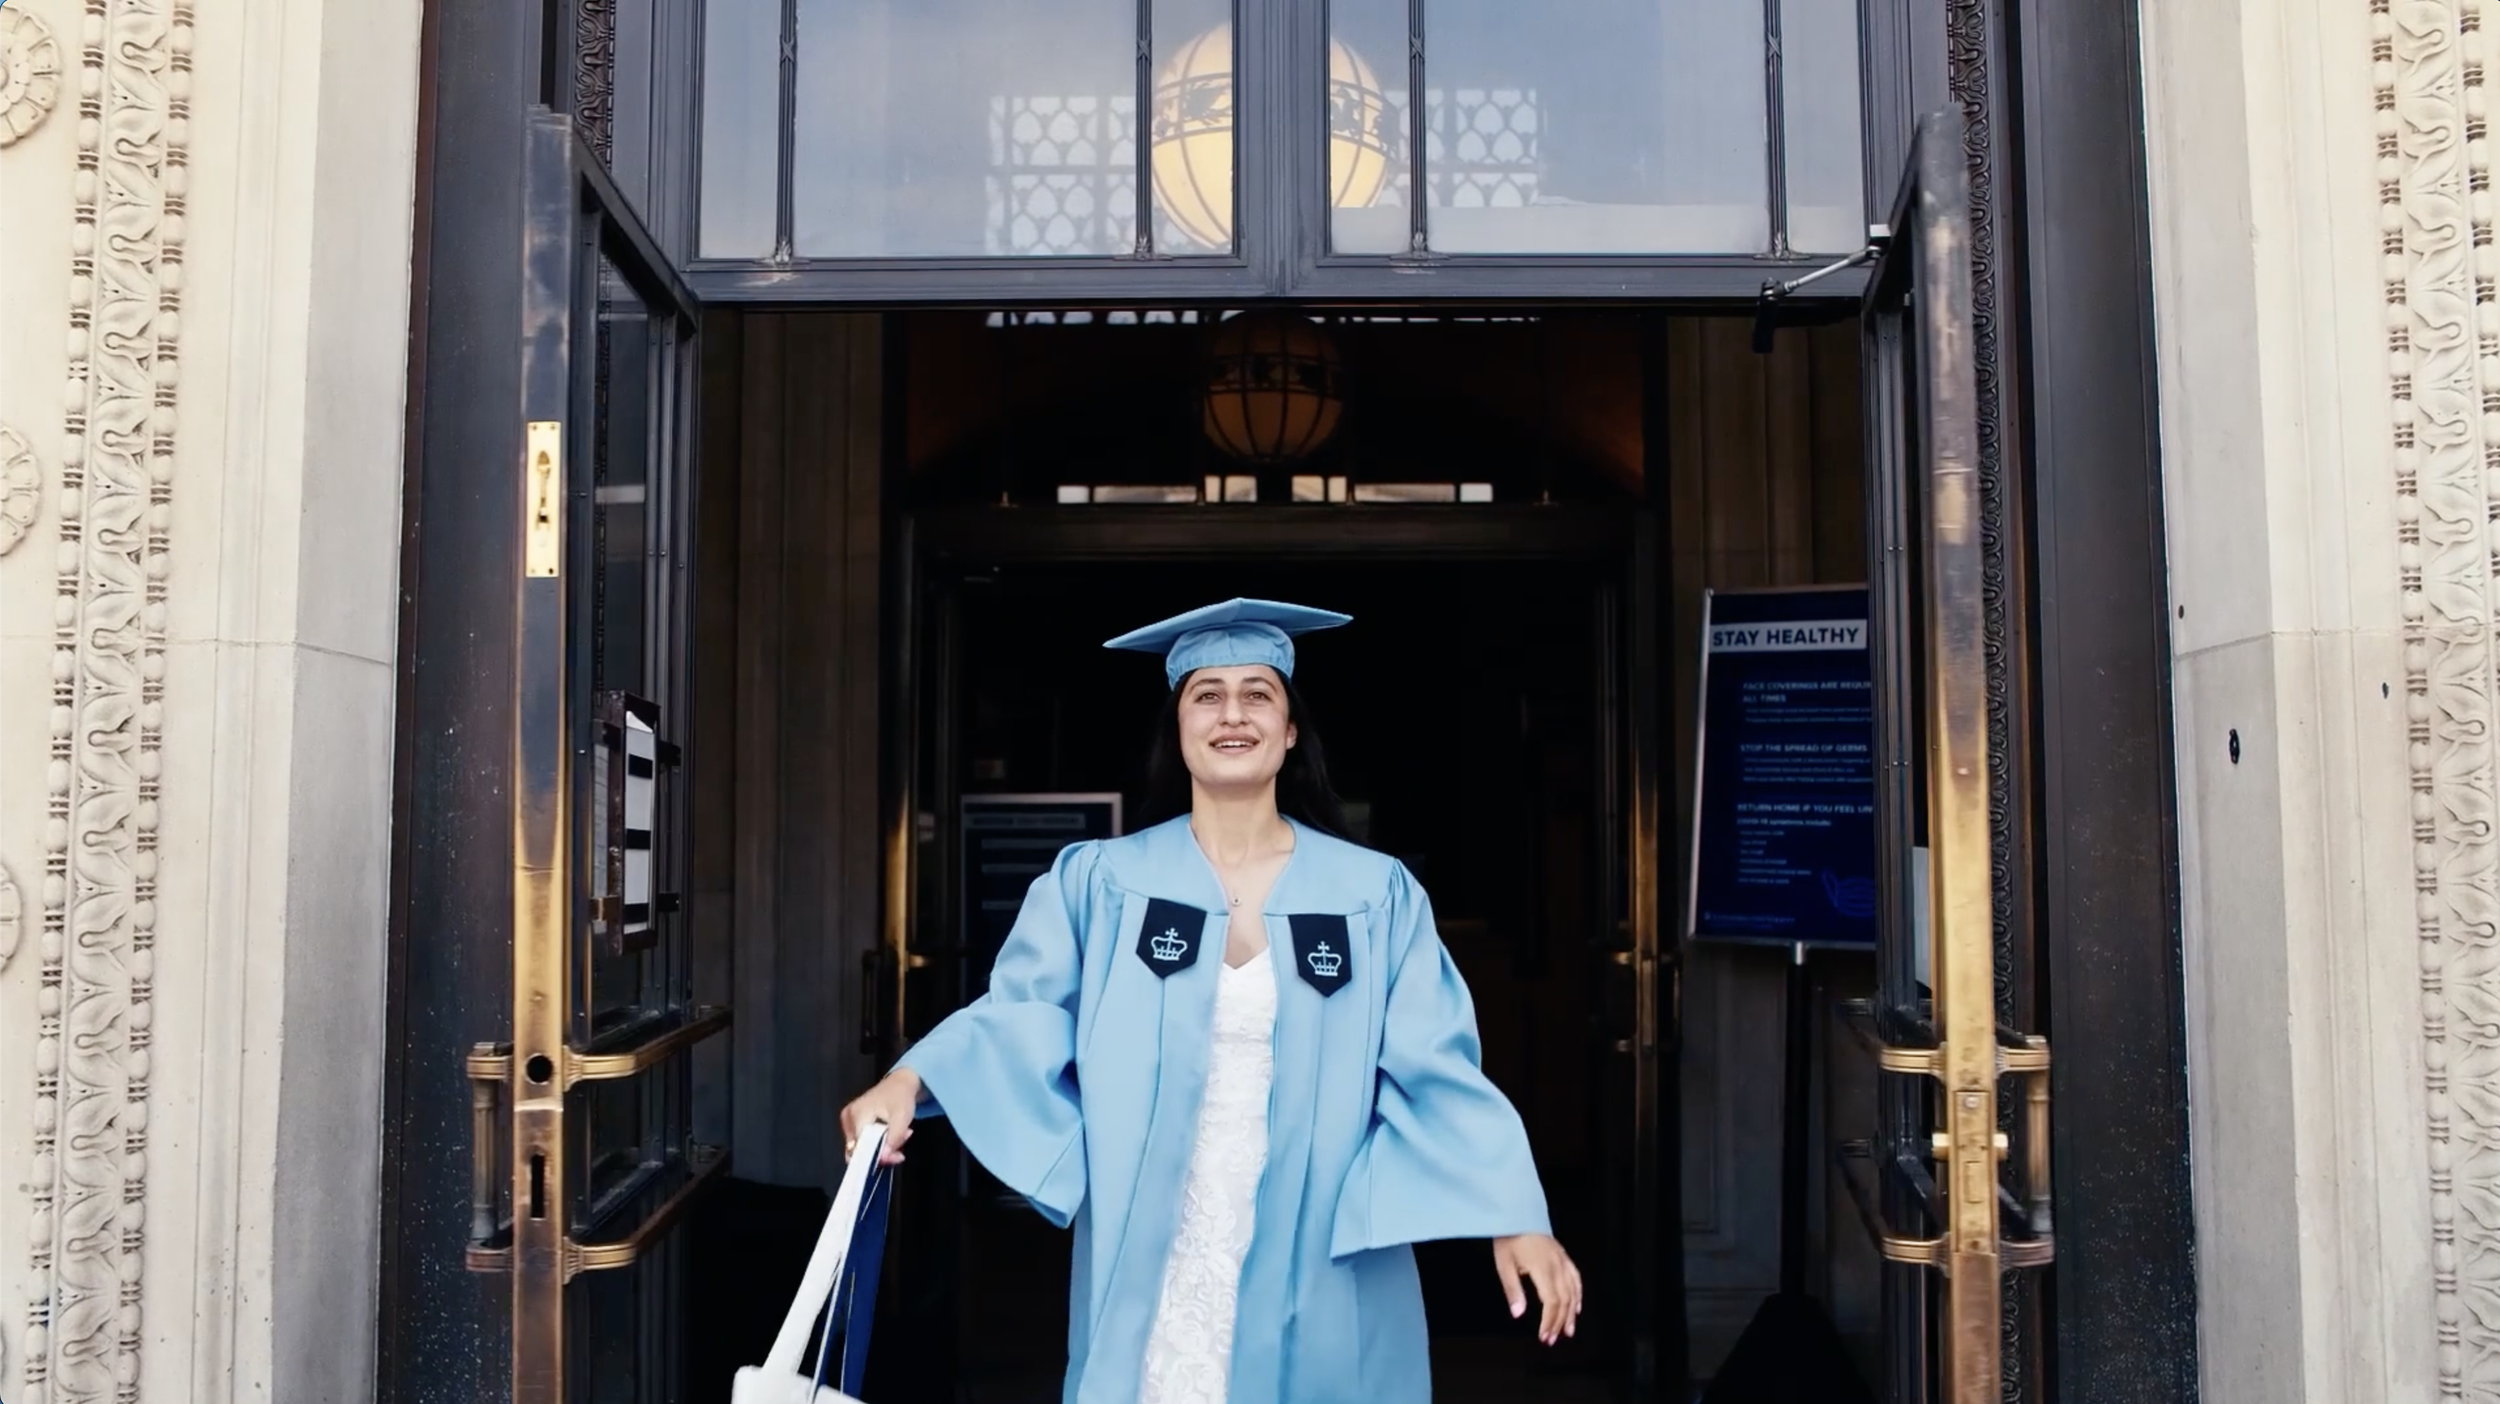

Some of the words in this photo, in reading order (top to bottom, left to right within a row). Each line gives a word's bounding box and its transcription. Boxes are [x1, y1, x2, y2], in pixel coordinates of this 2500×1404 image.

[1712, 629, 1760, 646] STAY
[1766, 627, 1860, 644] HEALTHY
[1820, 681, 1838, 690] ARE
[1760, 693, 1787, 702] TIMES
[1740, 744, 1763, 752] STOP
[1765, 744, 1782, 752] THE
[1784, 744, 1819, 752] SPREAD
[1821, 744, 1834, 752] OF
[1737, 803, 1772, 812] RETURN
[1773, 803, 1801, 812] HOME
[1802, 803, 1812, 812] IF
[1813, 804, 1833, 813] YOU
[1834, 804, 1855, 813] FEEL
